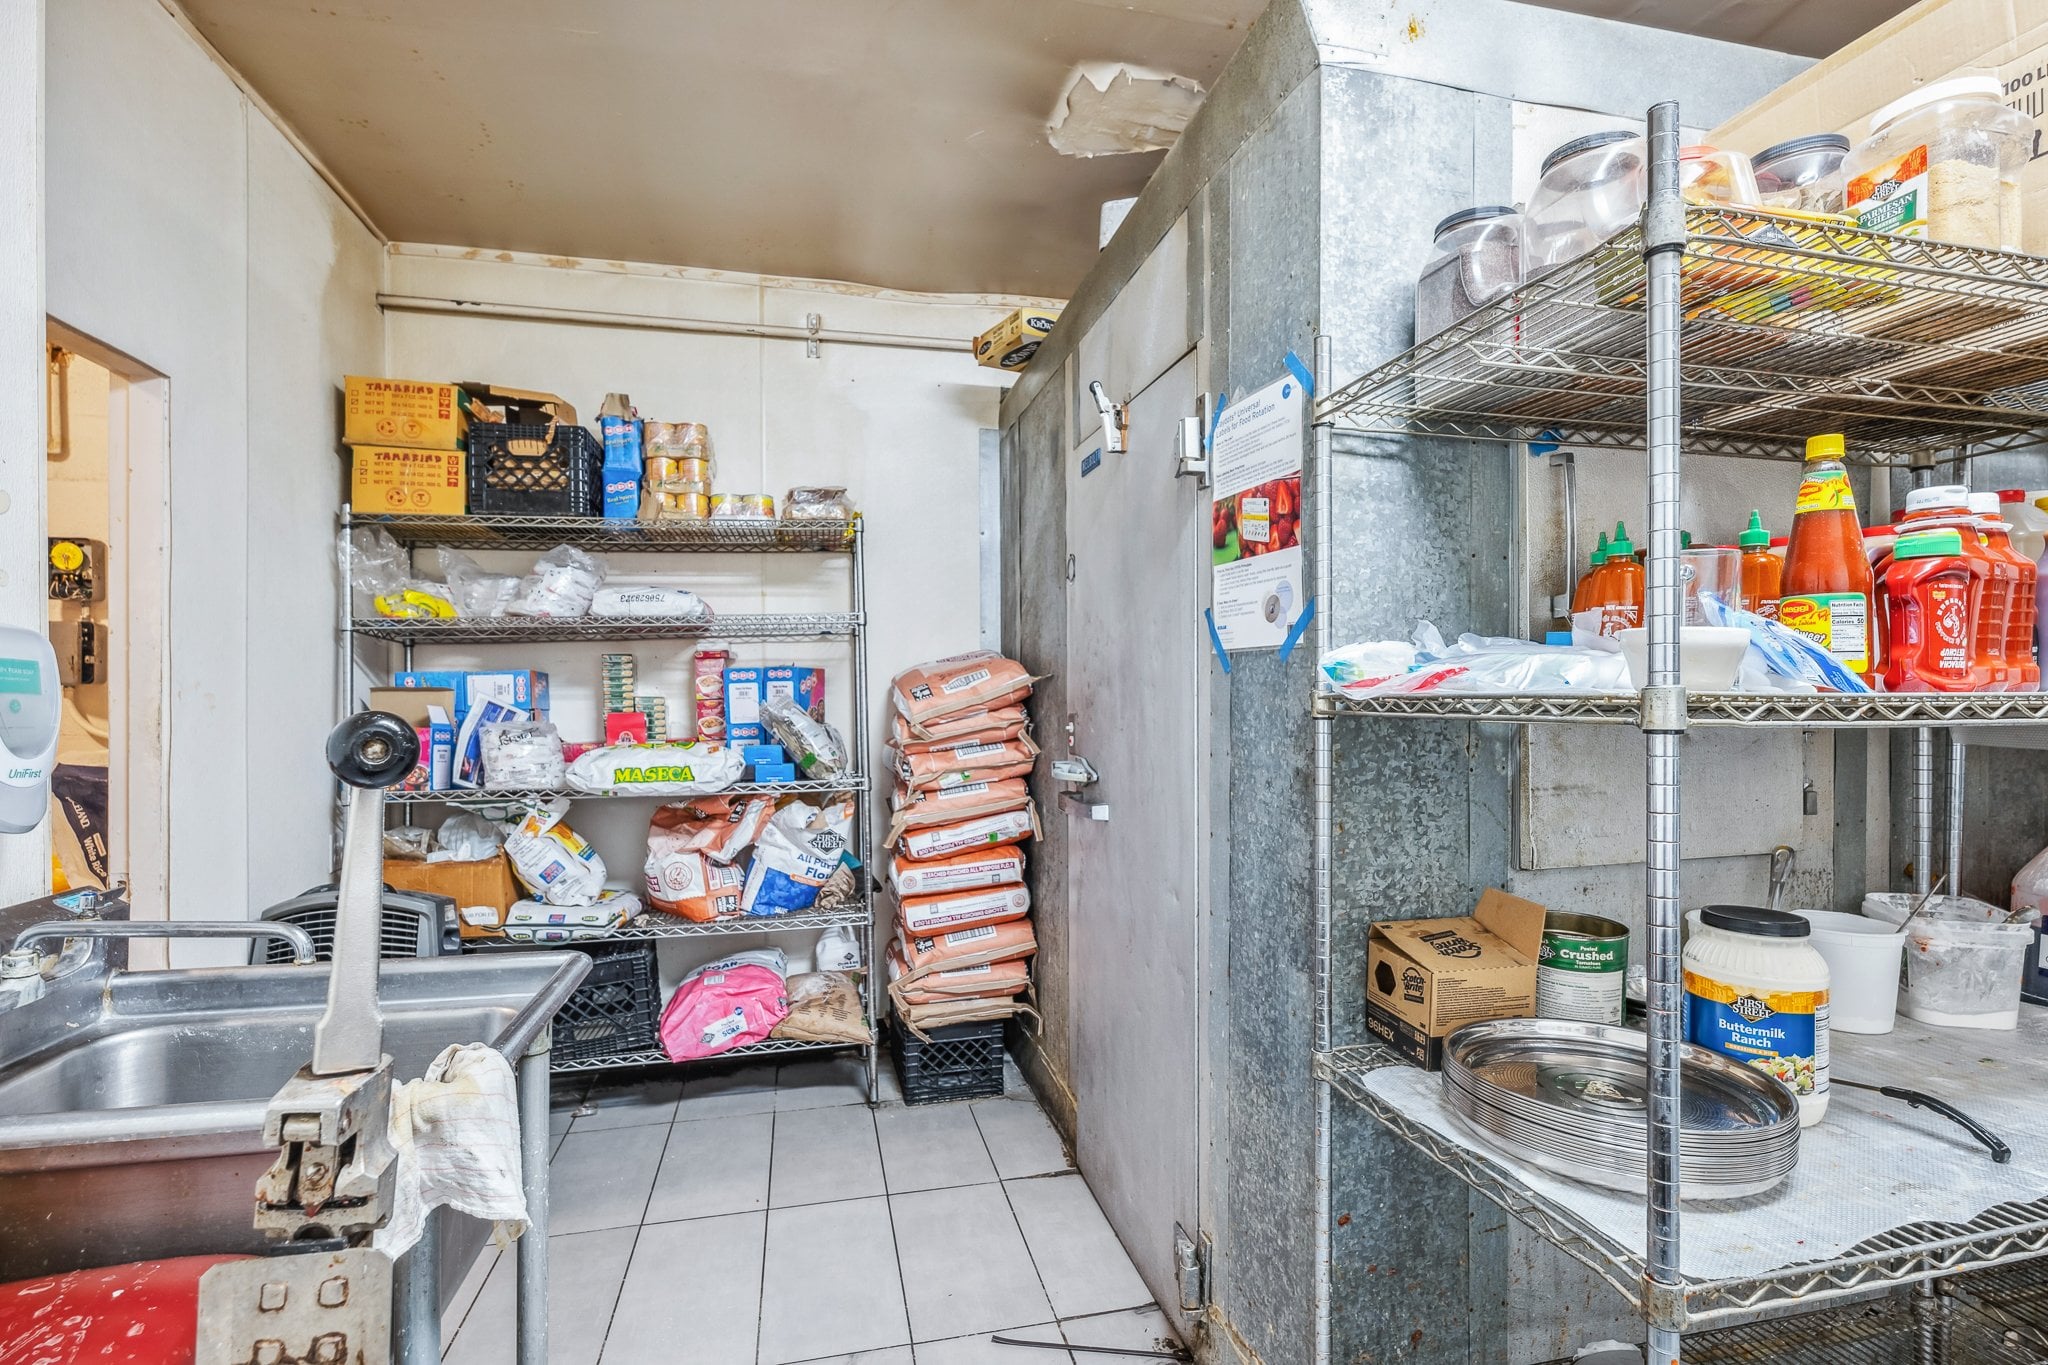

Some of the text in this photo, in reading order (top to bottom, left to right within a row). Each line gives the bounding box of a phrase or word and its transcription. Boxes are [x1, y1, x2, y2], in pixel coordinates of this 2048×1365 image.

[2003, 72, 2033, 96] 100
[1872, 183, 1899, 200] STREET
[1876, 179, 1897, 192] FIRST
[1860, 193, 1913, 223] PARMESAN
[1867, 206, 1905, 227] CHEESE
[1239, 415, 1251, 426] Food
[1252, 404, 1275, 420] Rotation
[1783, 604, 1809, 614] Maggi
[8, 768, 42, 779] UniFirst
[614, 765, 695, 784] MASECA
[811, 840, 844, 849] STREET
[817, 833, 840, 842] FIRST
[84, 836, 107, 877] White Rice
[797, 854, 811, 864] All
[1430, 937, 1470, 951] Brite
[1560, 948, 1614, 960] Crushed
[1401, 972, 1426, 985] Scotch-
[1403, 983, 1425, 996] Brite
[1737, 996, 1767, 1009] FIRST
[1732, 1003, 1772, 1019] STREET
[1368, 1017, 1394, 1042] 96HEX
[1718, 1018, 1786, 1039] Buttermilk
[1731, 1032, 1772, 1048] Ranch
